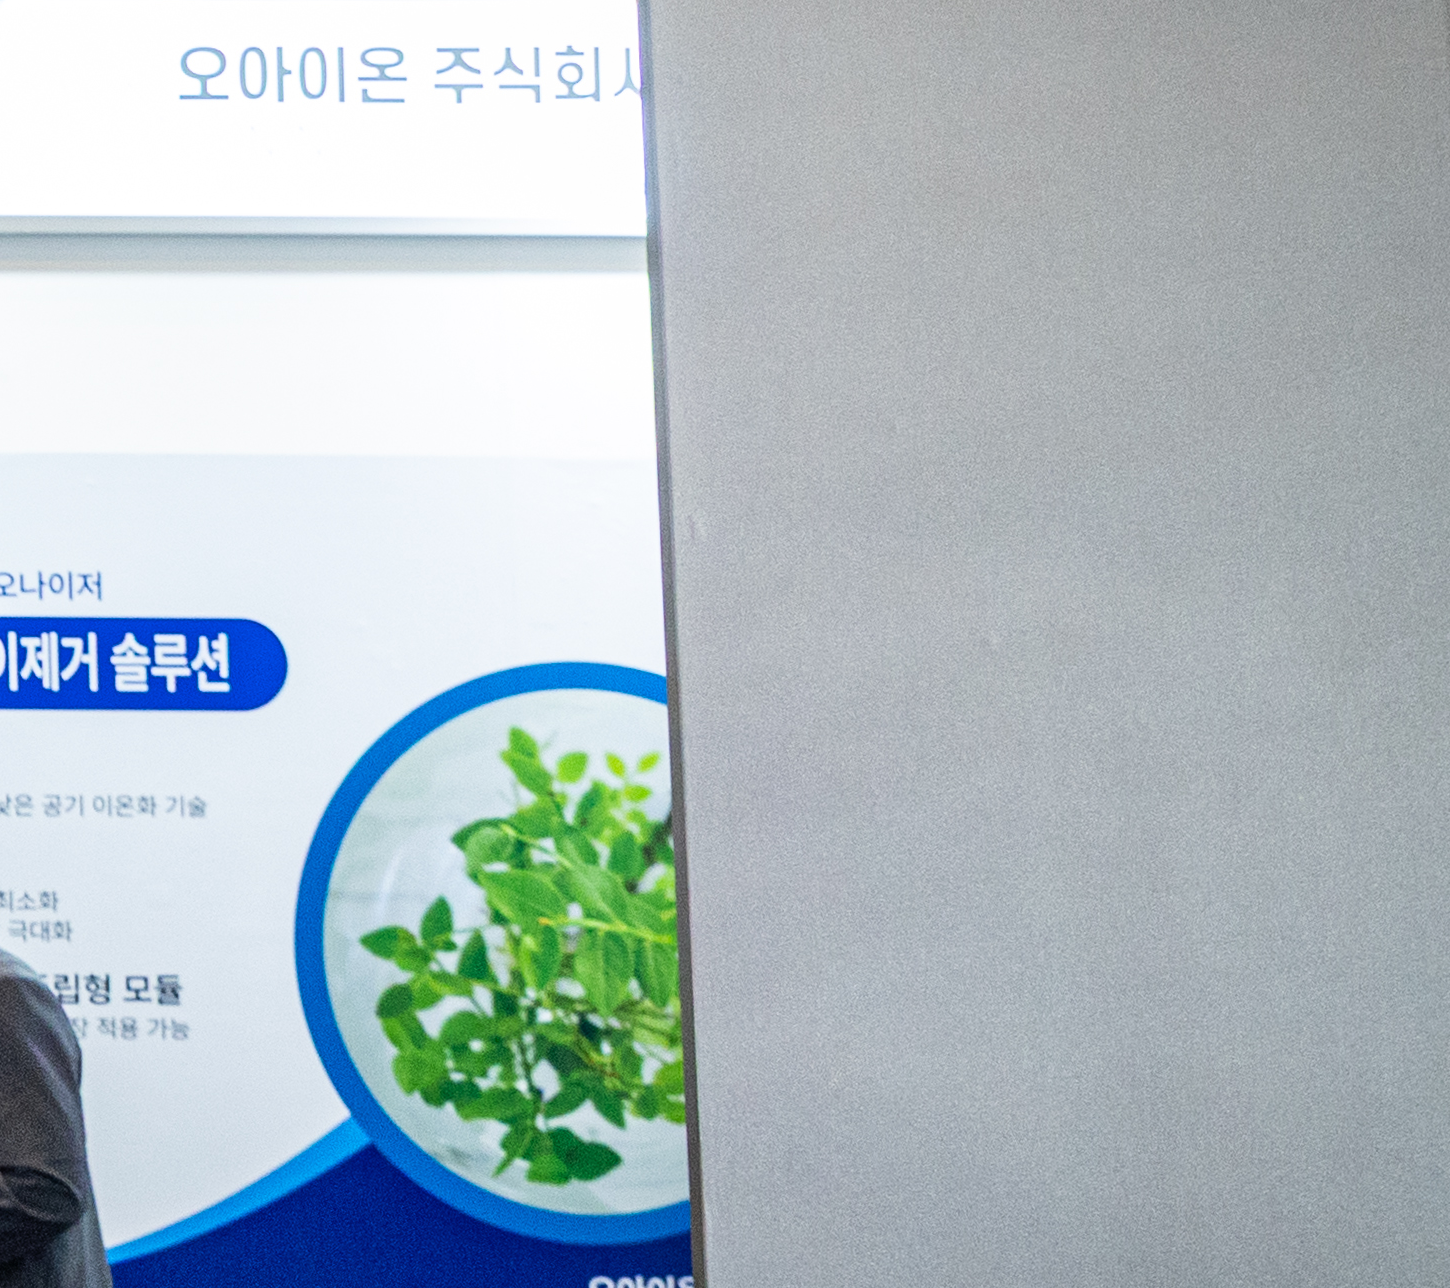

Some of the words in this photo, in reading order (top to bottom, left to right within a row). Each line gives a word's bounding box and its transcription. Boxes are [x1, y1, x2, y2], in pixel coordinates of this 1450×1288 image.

[178, 46, 408, 104] 오아이온
[109, 630, 232, 694] 솔루션
[42, 793, 86, 819] 공기
[165, 794, 208, 819] 기술
[37, 972, 112, 1006] 립형
[122, 973, 184, 1007] 모듈
